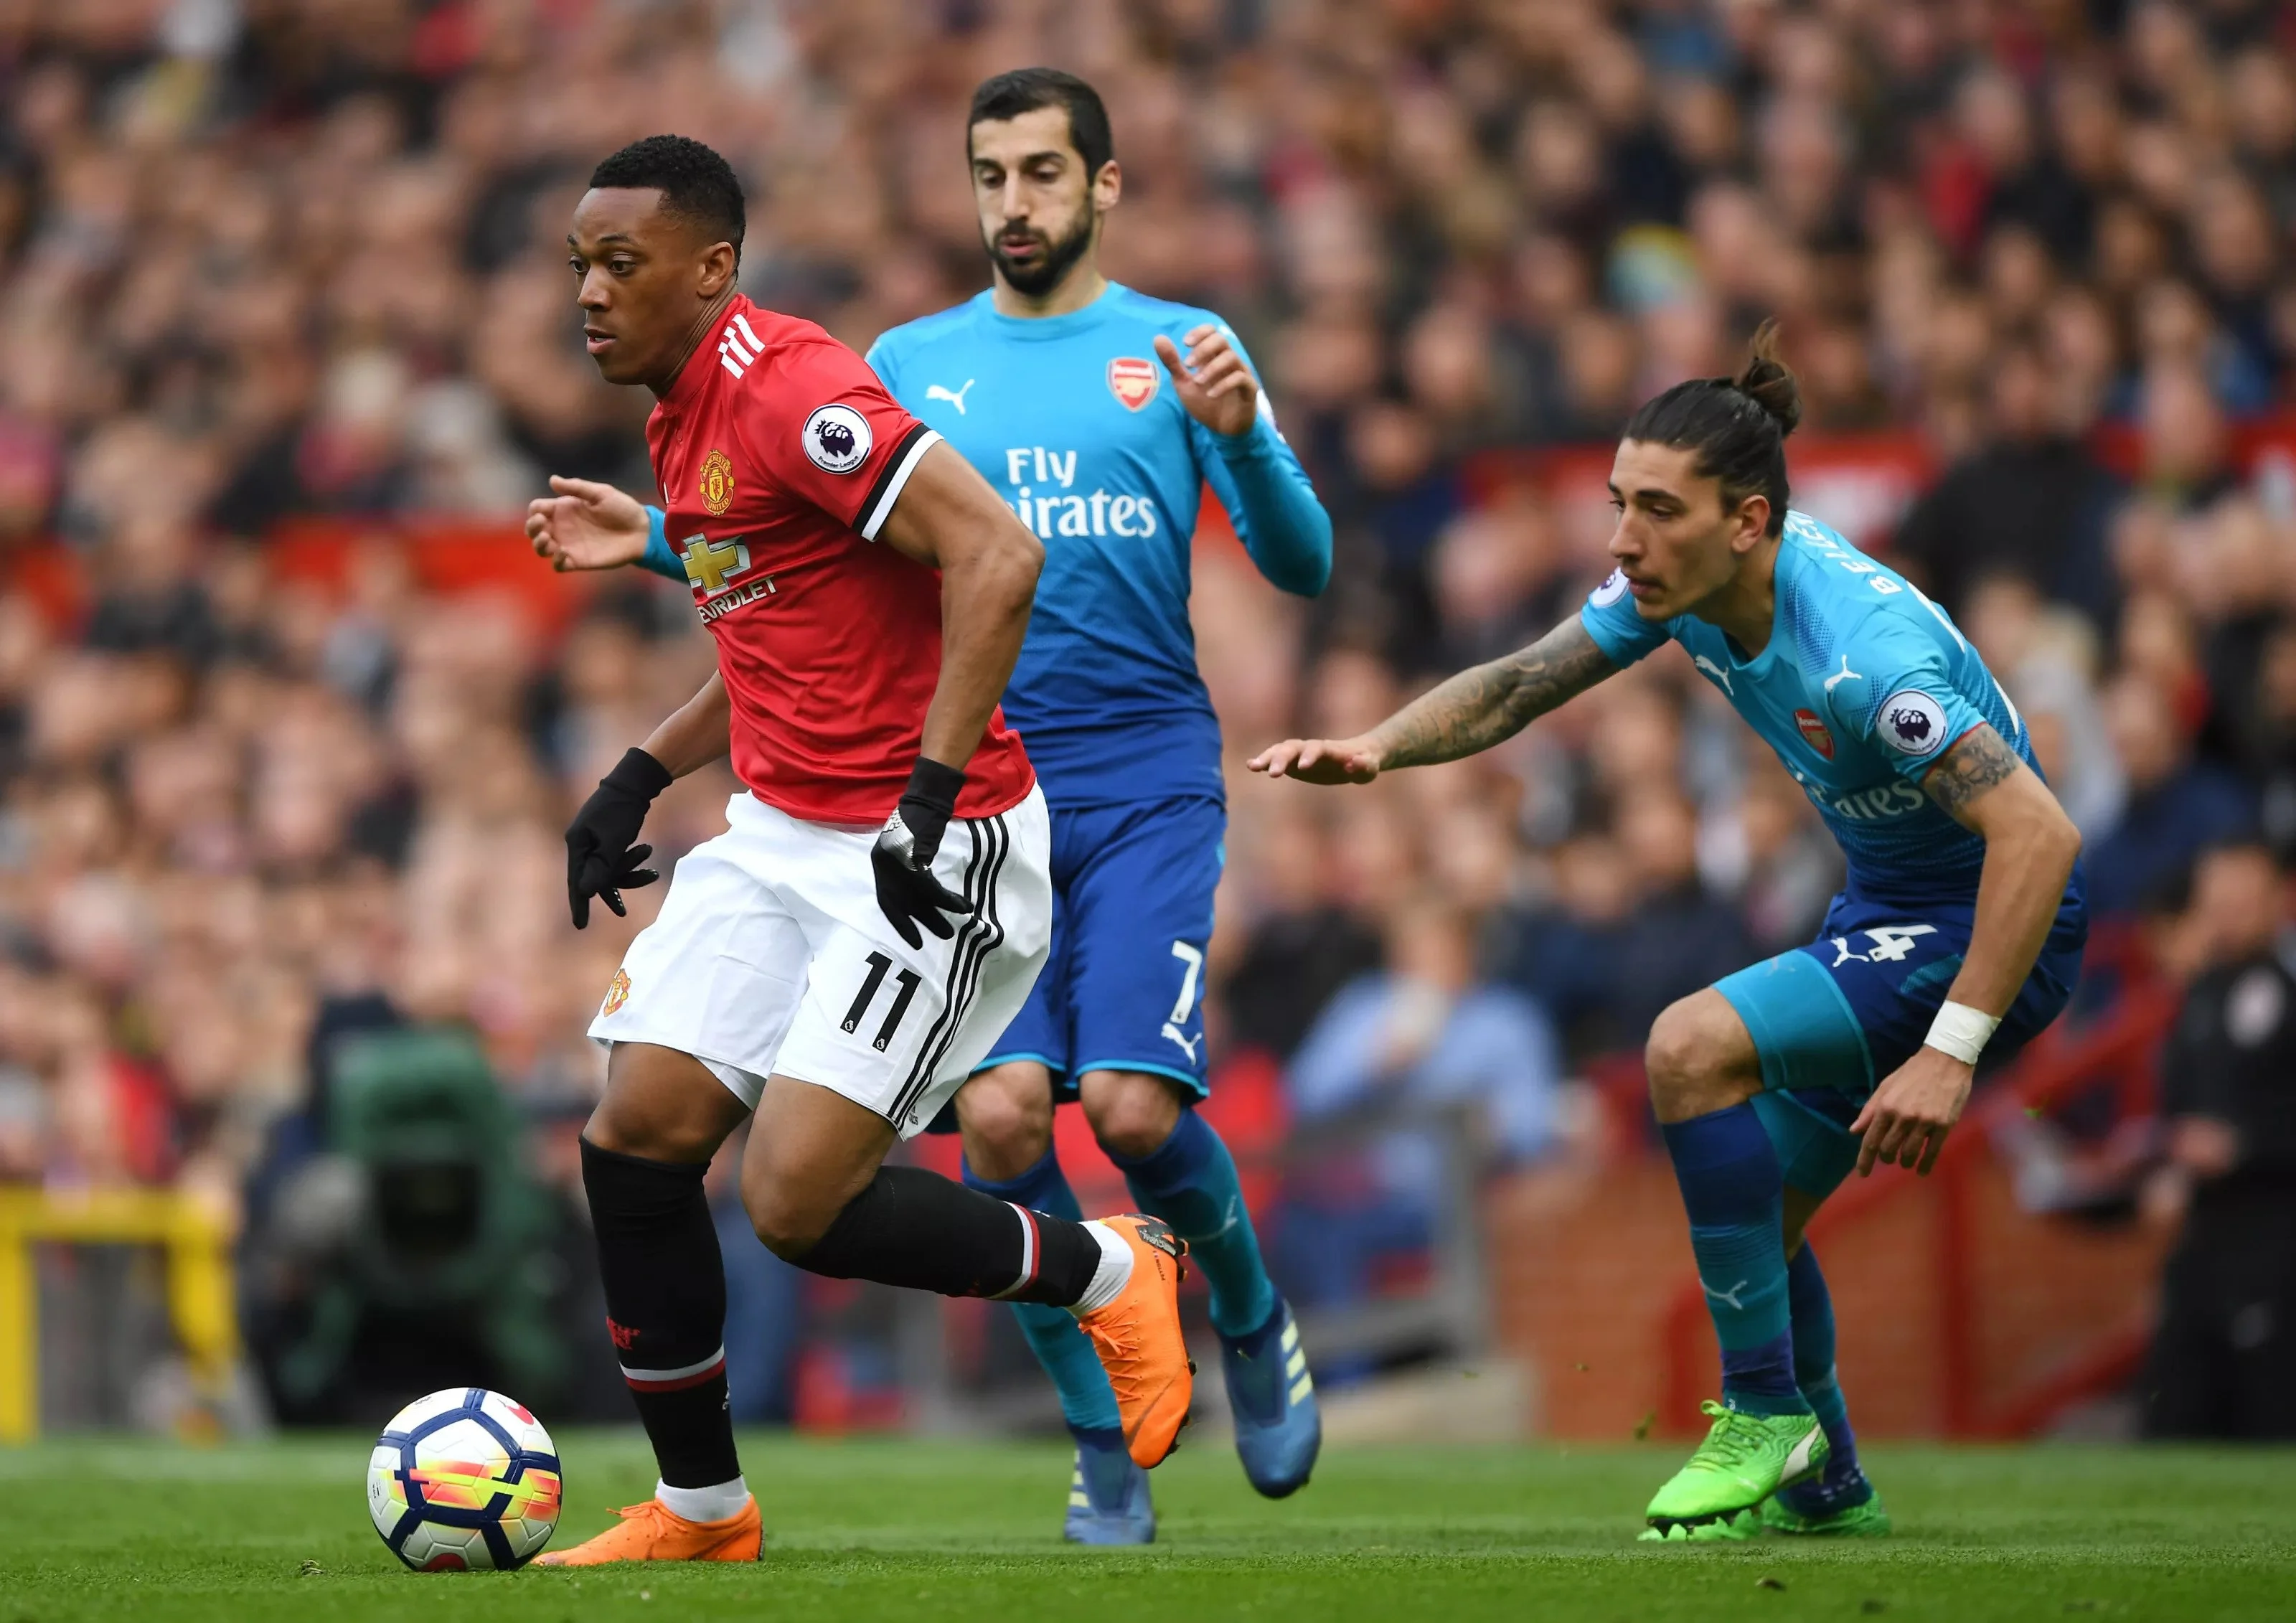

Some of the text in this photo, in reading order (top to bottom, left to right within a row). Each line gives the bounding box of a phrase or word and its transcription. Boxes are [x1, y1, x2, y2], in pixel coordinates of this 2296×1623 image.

[818, 456, 839, 468] Premier
[1005, 446, 1077, 489] Fly
[707, 497, 730, 511] UNITED
[1006, 486, 1157, 539] irates
[697, 574, 777, 624] EVROLET
[839, 950, 923, 1053] 11
[1170, 939, 1203, 1025] 7
